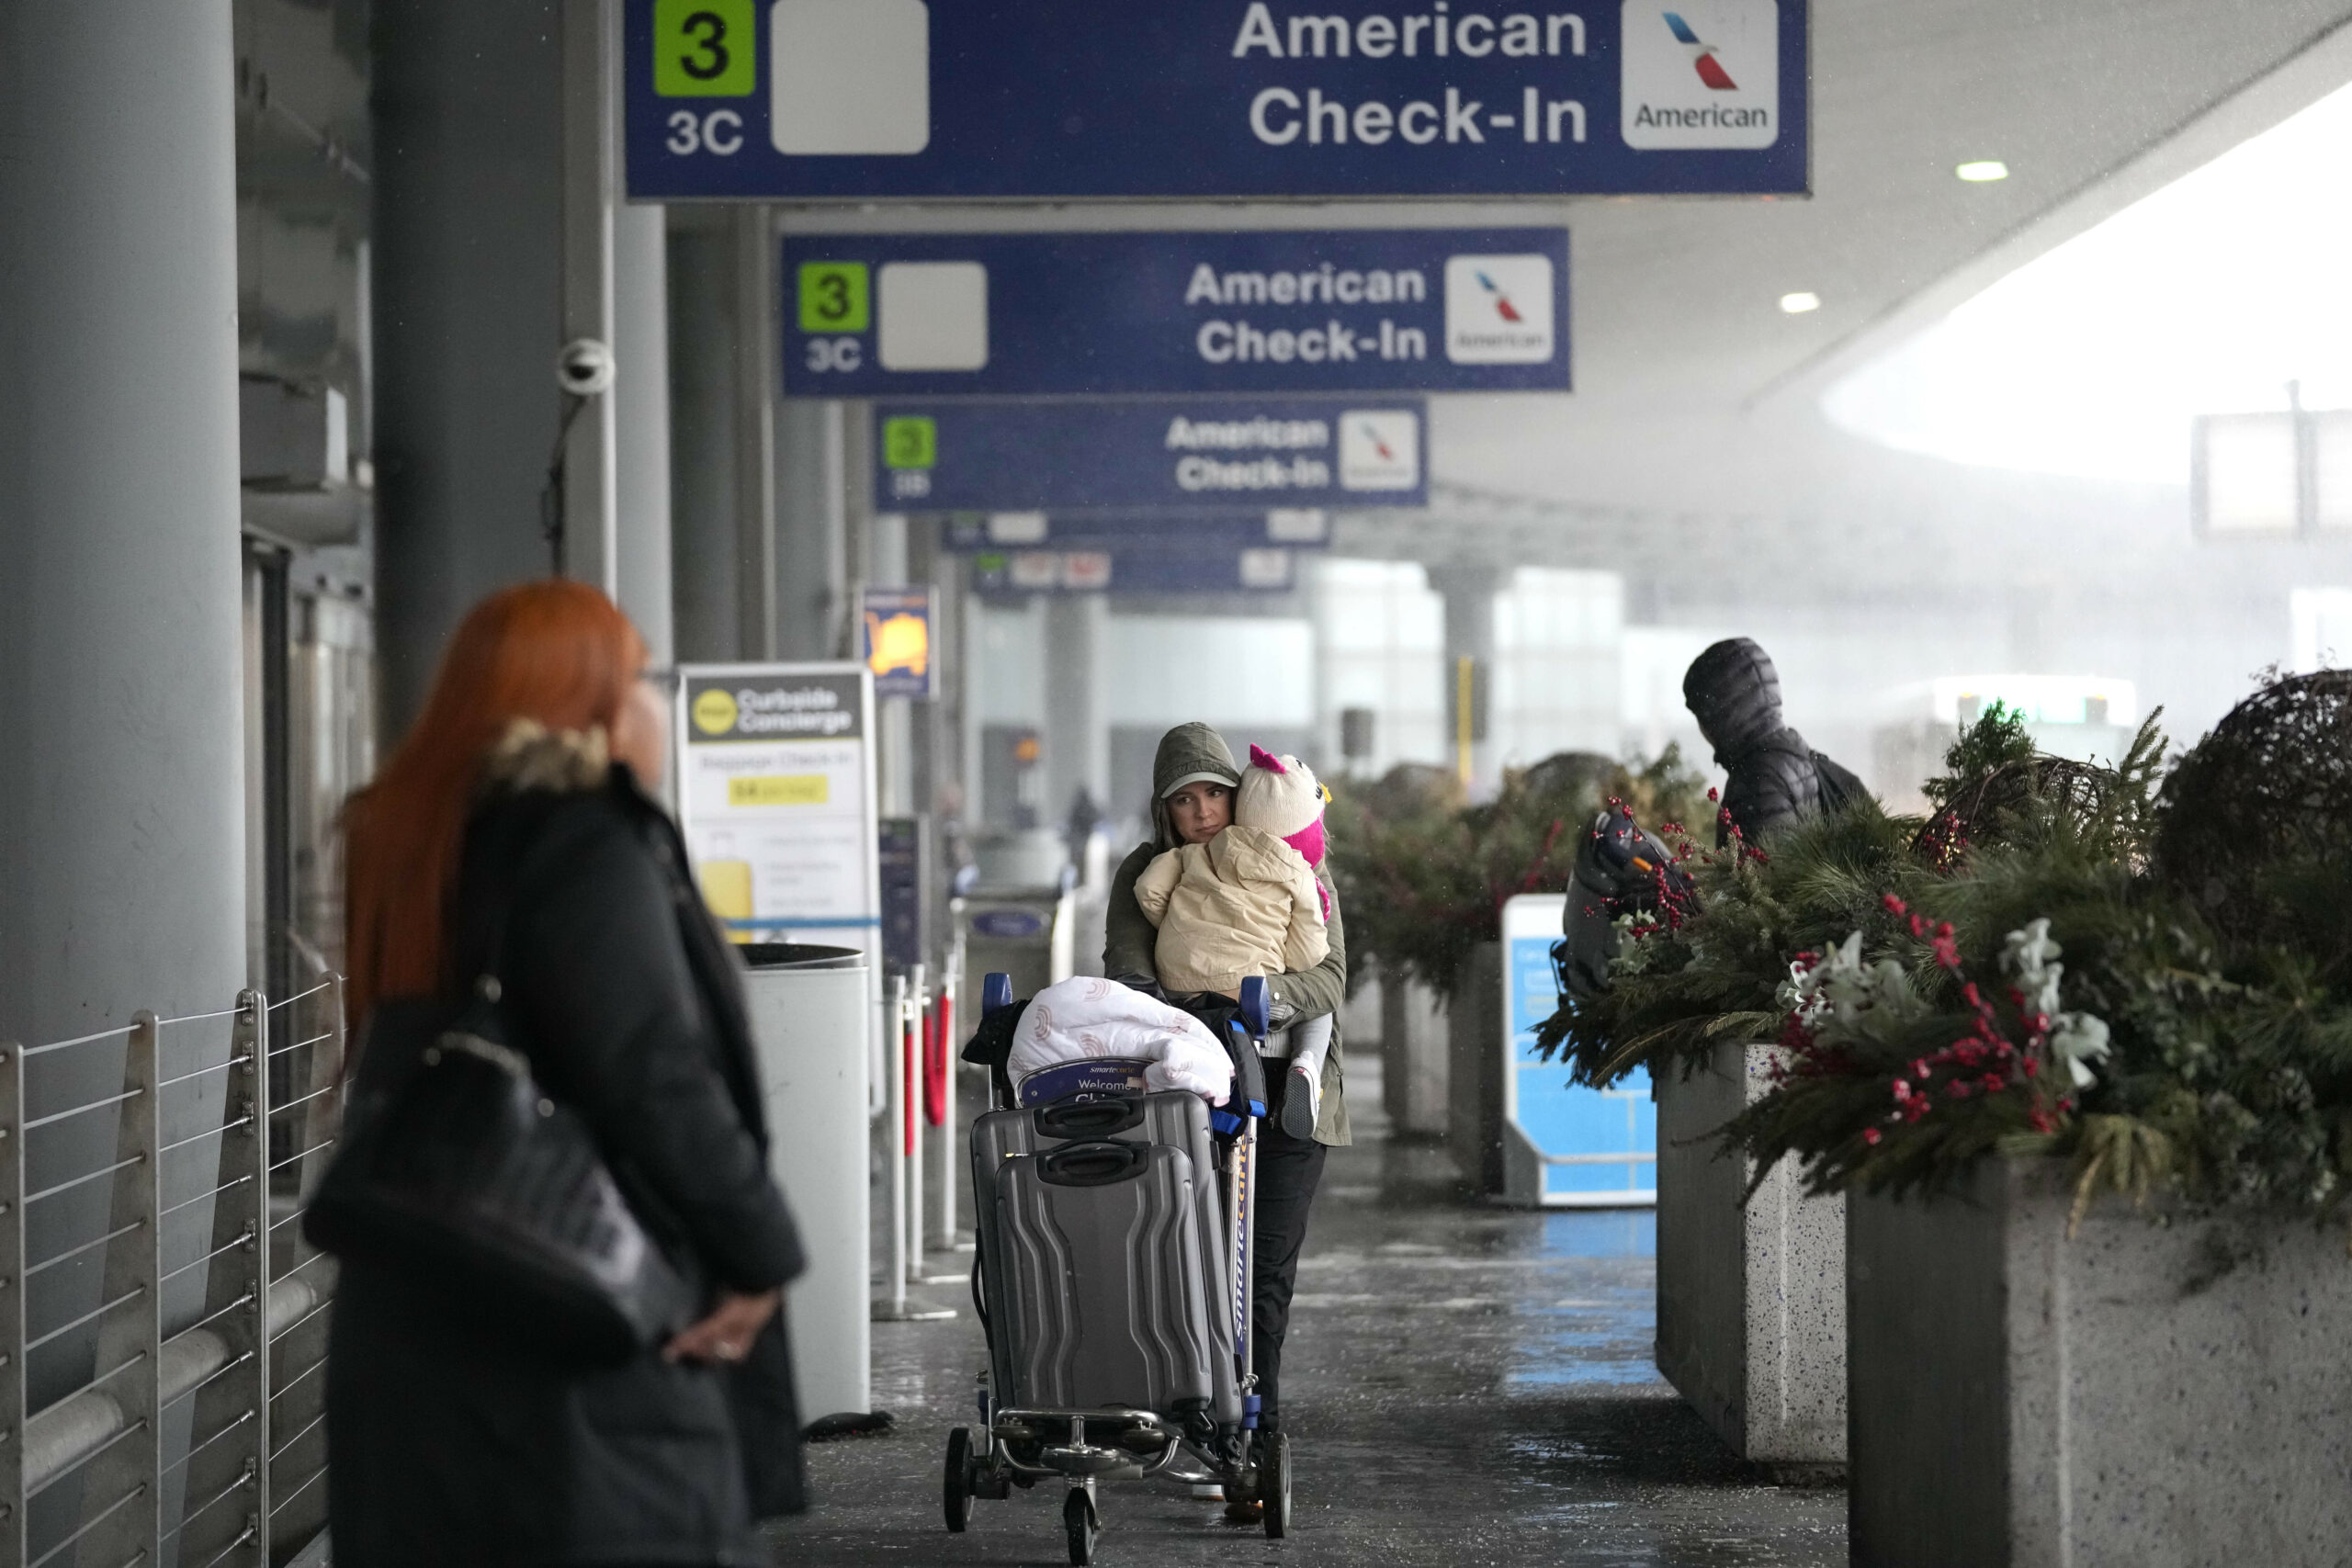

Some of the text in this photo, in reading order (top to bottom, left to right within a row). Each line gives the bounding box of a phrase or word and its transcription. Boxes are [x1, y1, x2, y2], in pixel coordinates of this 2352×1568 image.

[680, 11, 729, 80] 3
[1232, 1, 1586, 57] American
[667, 109, 743, 154] 3C
[1250, 86, 1586, 144] Check-In
[1635, 103, 1768, 129] American
[816, 274, 851, 321] 3
[1185, 264, 1426, 304] American
[807, 337, 862, 372] 3C
[1196, 320, 1427, 363] Check-In
[1167, 417, 1329, 449] American
[1176, 457, 1329, 491] Check-In
[738, 687, 838, 710] Curbside
[738, 710, 853, 735] Concierge
